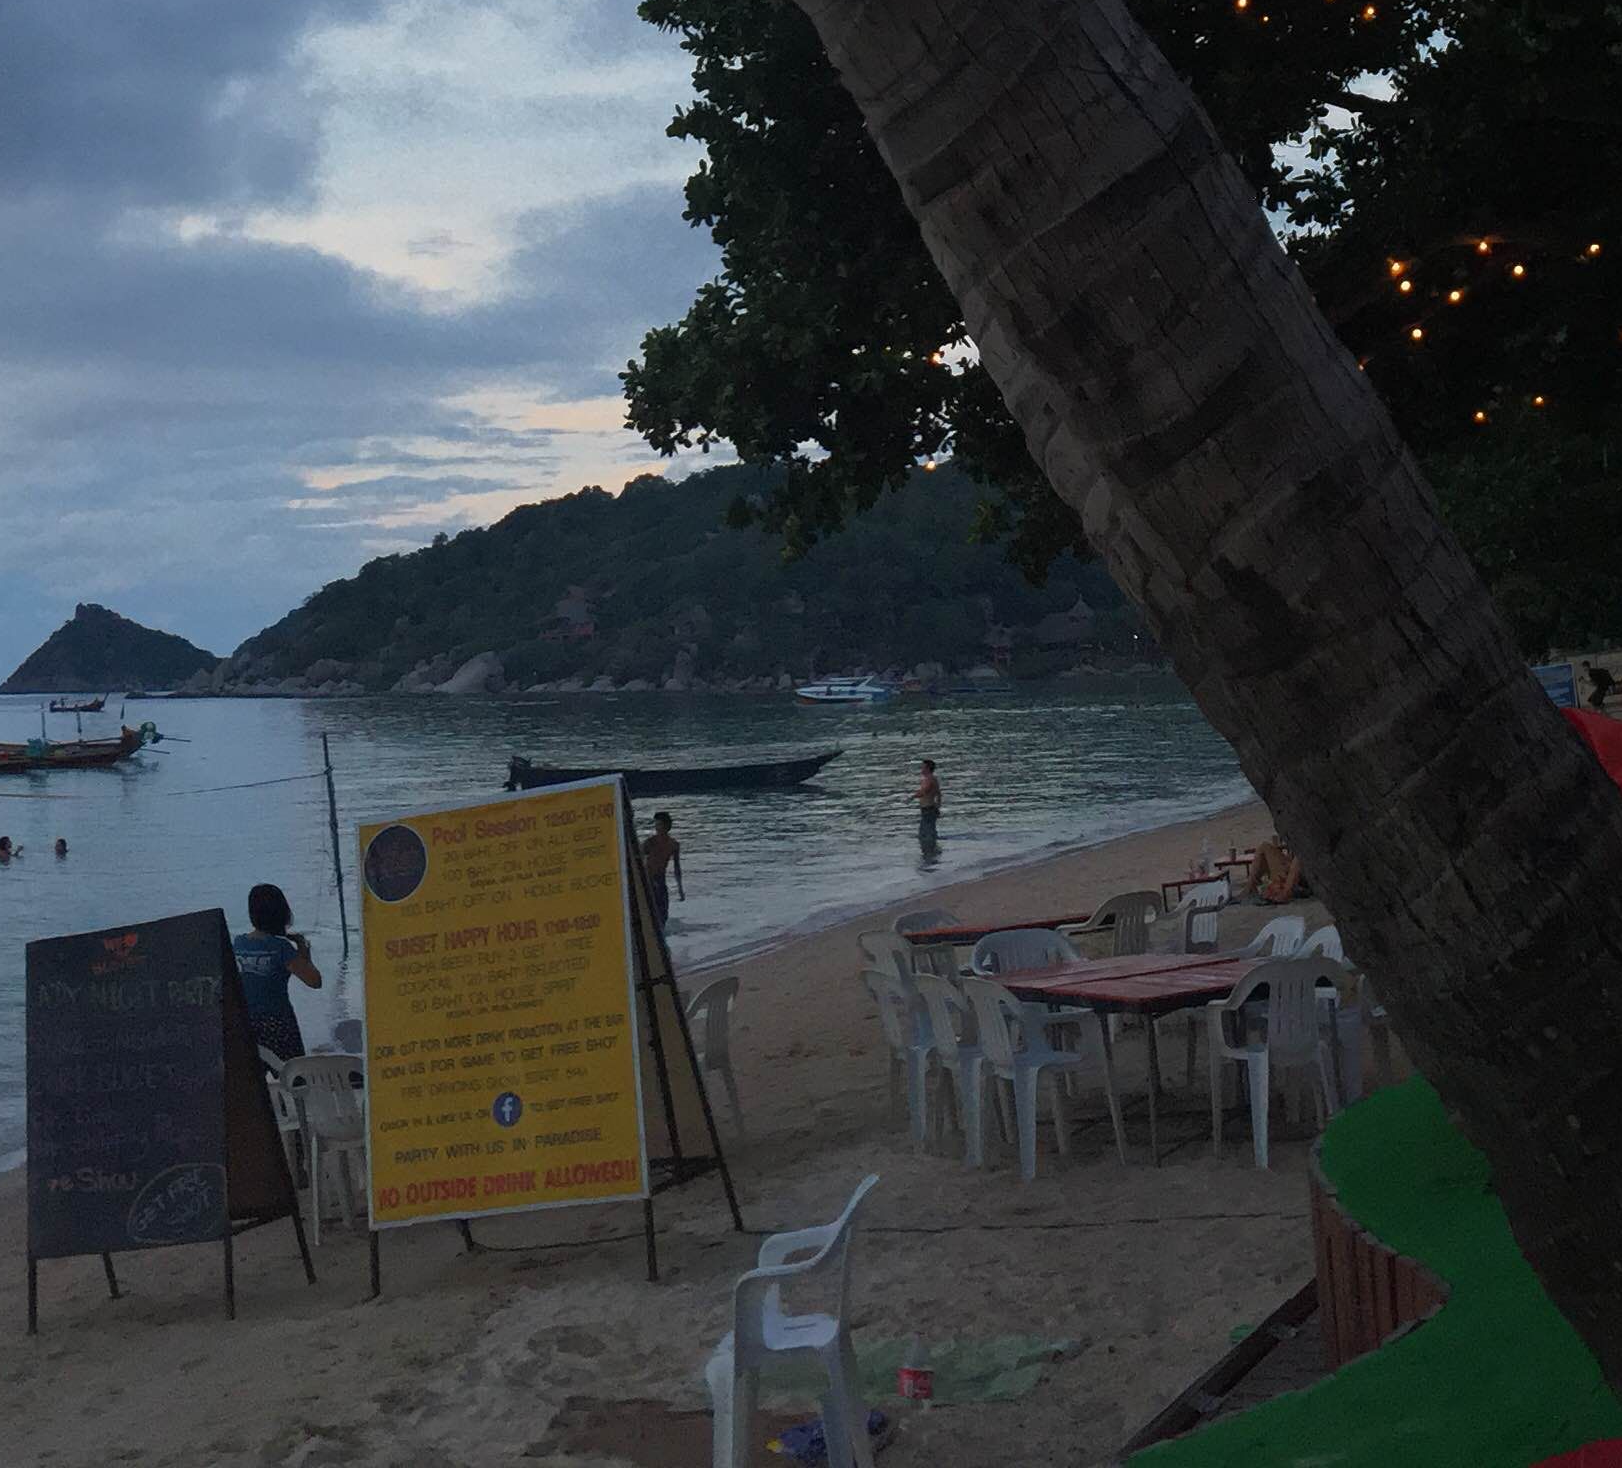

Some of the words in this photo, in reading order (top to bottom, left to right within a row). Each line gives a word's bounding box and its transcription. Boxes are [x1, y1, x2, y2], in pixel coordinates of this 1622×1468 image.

[432, 822, 467, 847] Pool
[474, 814, 537, 841] Session
[463, 845, 492, 861] BAHT
[548, 833, 570, 846] ALL
[527, 852, 568, 870] HOUSE
[425, 897, 456, 914] BAHT
[462, 894, 488, 909] OFF
[491, 889, 513, 905] ON
[523, 882, 563, 899] HOUSE
[385, 933, 438, 961] SUNSET
[444, 926, 490, 951] HAPPY
[496, 919, 538, 943] HOUR
[440, 954, 474, 971] BEER
[478, 949, 501, 966] BUY
[508, 948, 517, 962] 2
[522, 945, 545, 960] GET
[566, 935, 593, 951] FREE
[487, 965, 521, 982] BAHT
[432, 994, 464, 1012] BAHT
[494, 983, 536, 1001] HOUSE
[420, 1038, 441, 1053] FOR
[444, 1034, 473, 1050] MORE
[476, 1029, 505, 1048] DRINK
[508, 1022, 563, 1041] PROMOTION
[566, 1019, 579, 1034] AT
[584, 1017, 601, 1030] THE
[605, 1013, 625, 1029] BAR
[408, 1061, 426, 1076] US
[430, 1058, 456, 1074] FOR
[461, 1053, 496, 1070] GAME
[500, 1050, 516, 1065] TO
[520, 1044, 545, 1062] GET
[551, 1040, 582, 1057] FREE
[585, 1035, 618, 1053] SHOT
[394, 1147, 439, 1165] PARTY
[446, 1142, 481, 1160] WITH
[486, 1140, 505, 1156] US
[512, 1137, 528, 1152] IN
[534, 1127, 601, 1149] PARADISE
[378, 1187, 401, 1211] NO
[405, 1175, 477, 1206] OUTSIDE
[482, 1170, 536, 1198] DRINK
